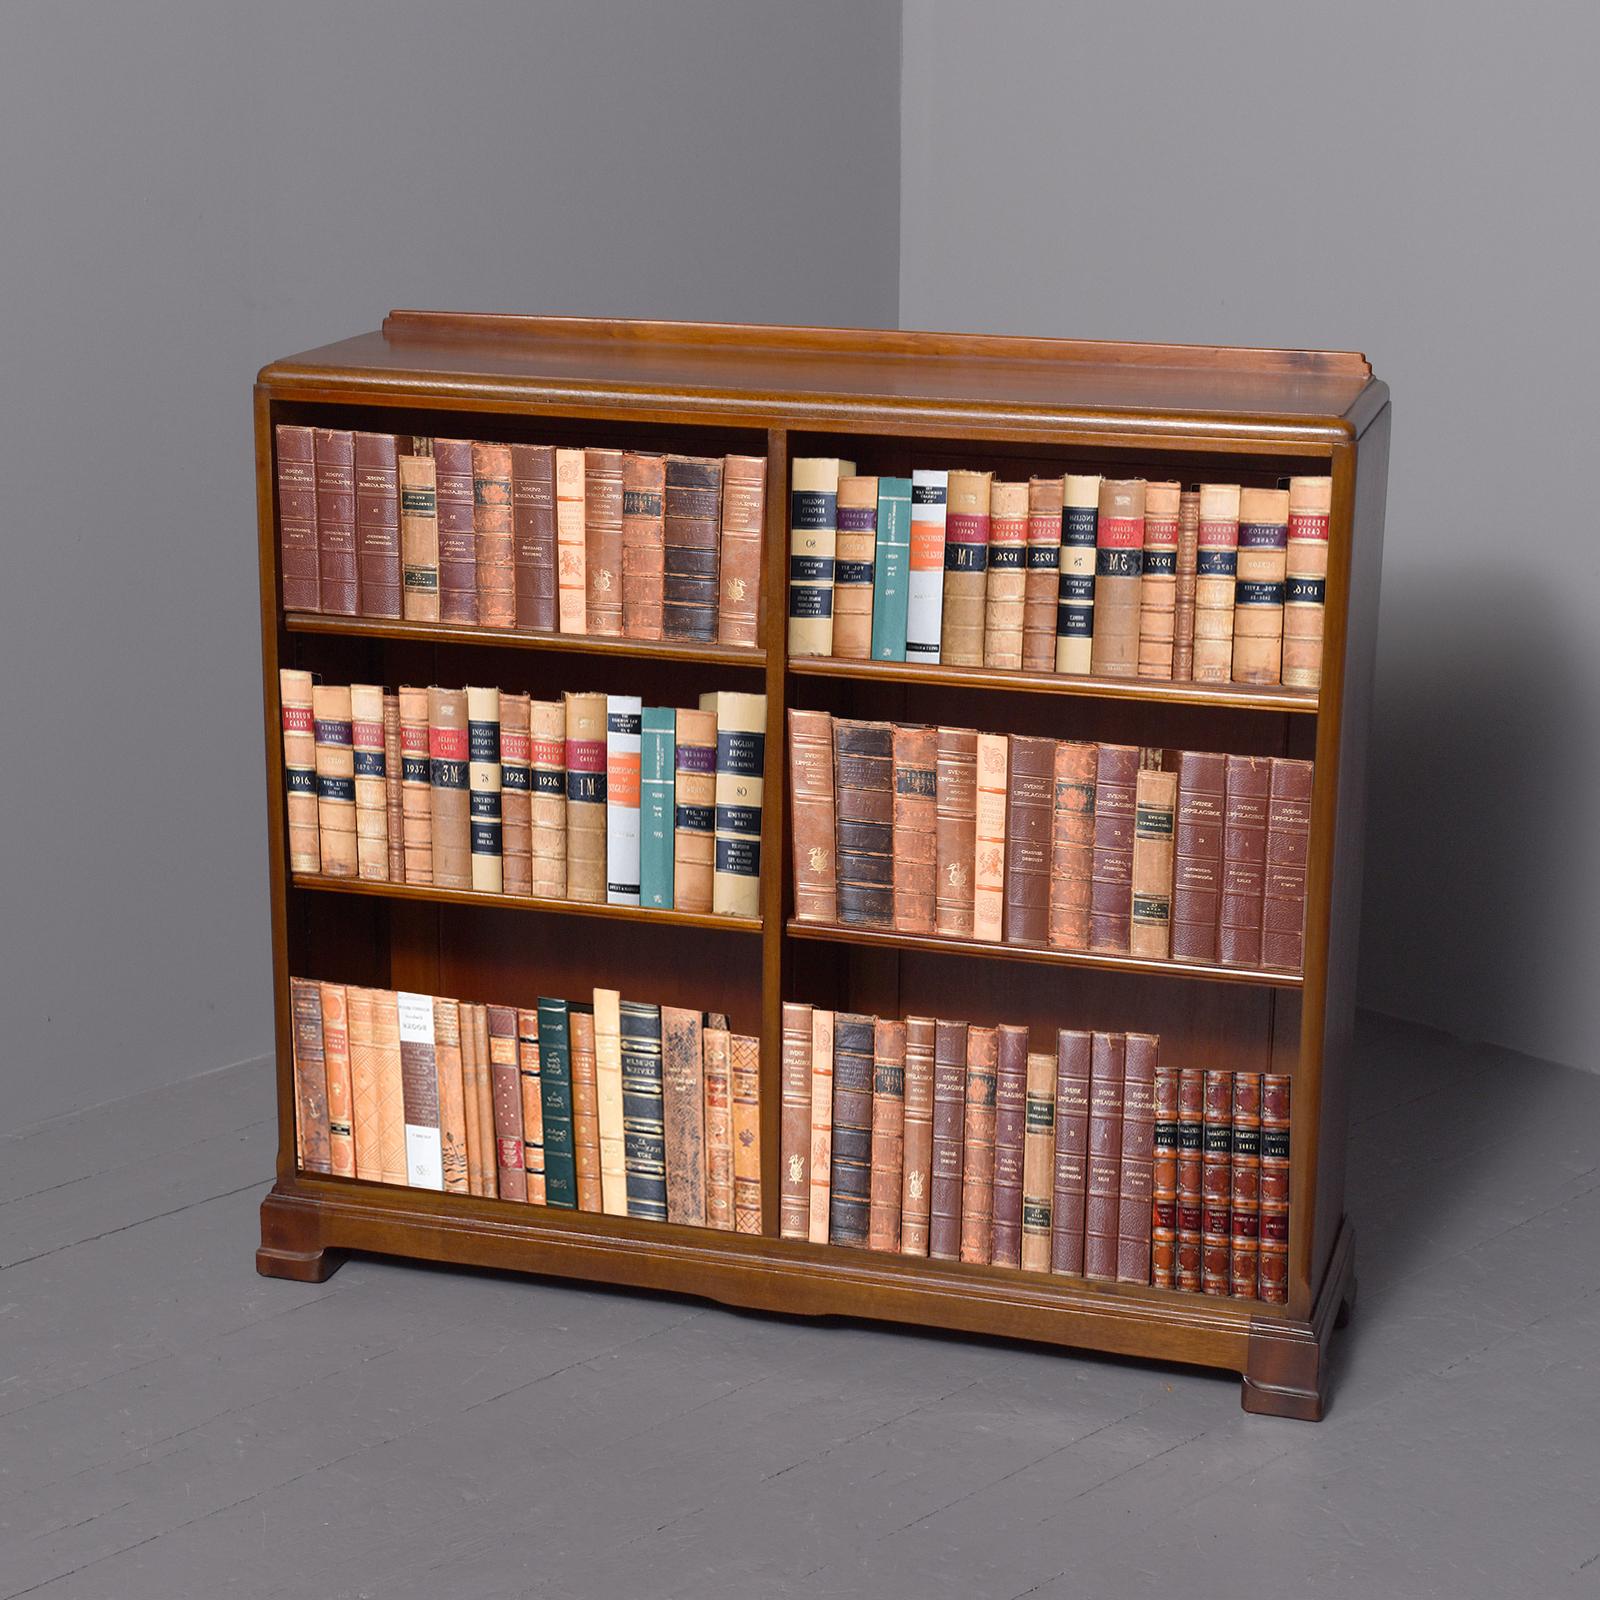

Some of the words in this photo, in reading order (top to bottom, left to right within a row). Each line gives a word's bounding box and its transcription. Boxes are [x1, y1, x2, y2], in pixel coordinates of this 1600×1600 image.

[285, 710, 311, 720] SESSION
[289, 718, 308, 728] CASES
[406, 764, 426, 774] 1937.
[291, 775, 312, 785] 1916.
[505, 772, 526, 784] 1925.
[538, 776, 560, 788] 1926.
[789, 1214, 801, 1226] 28
